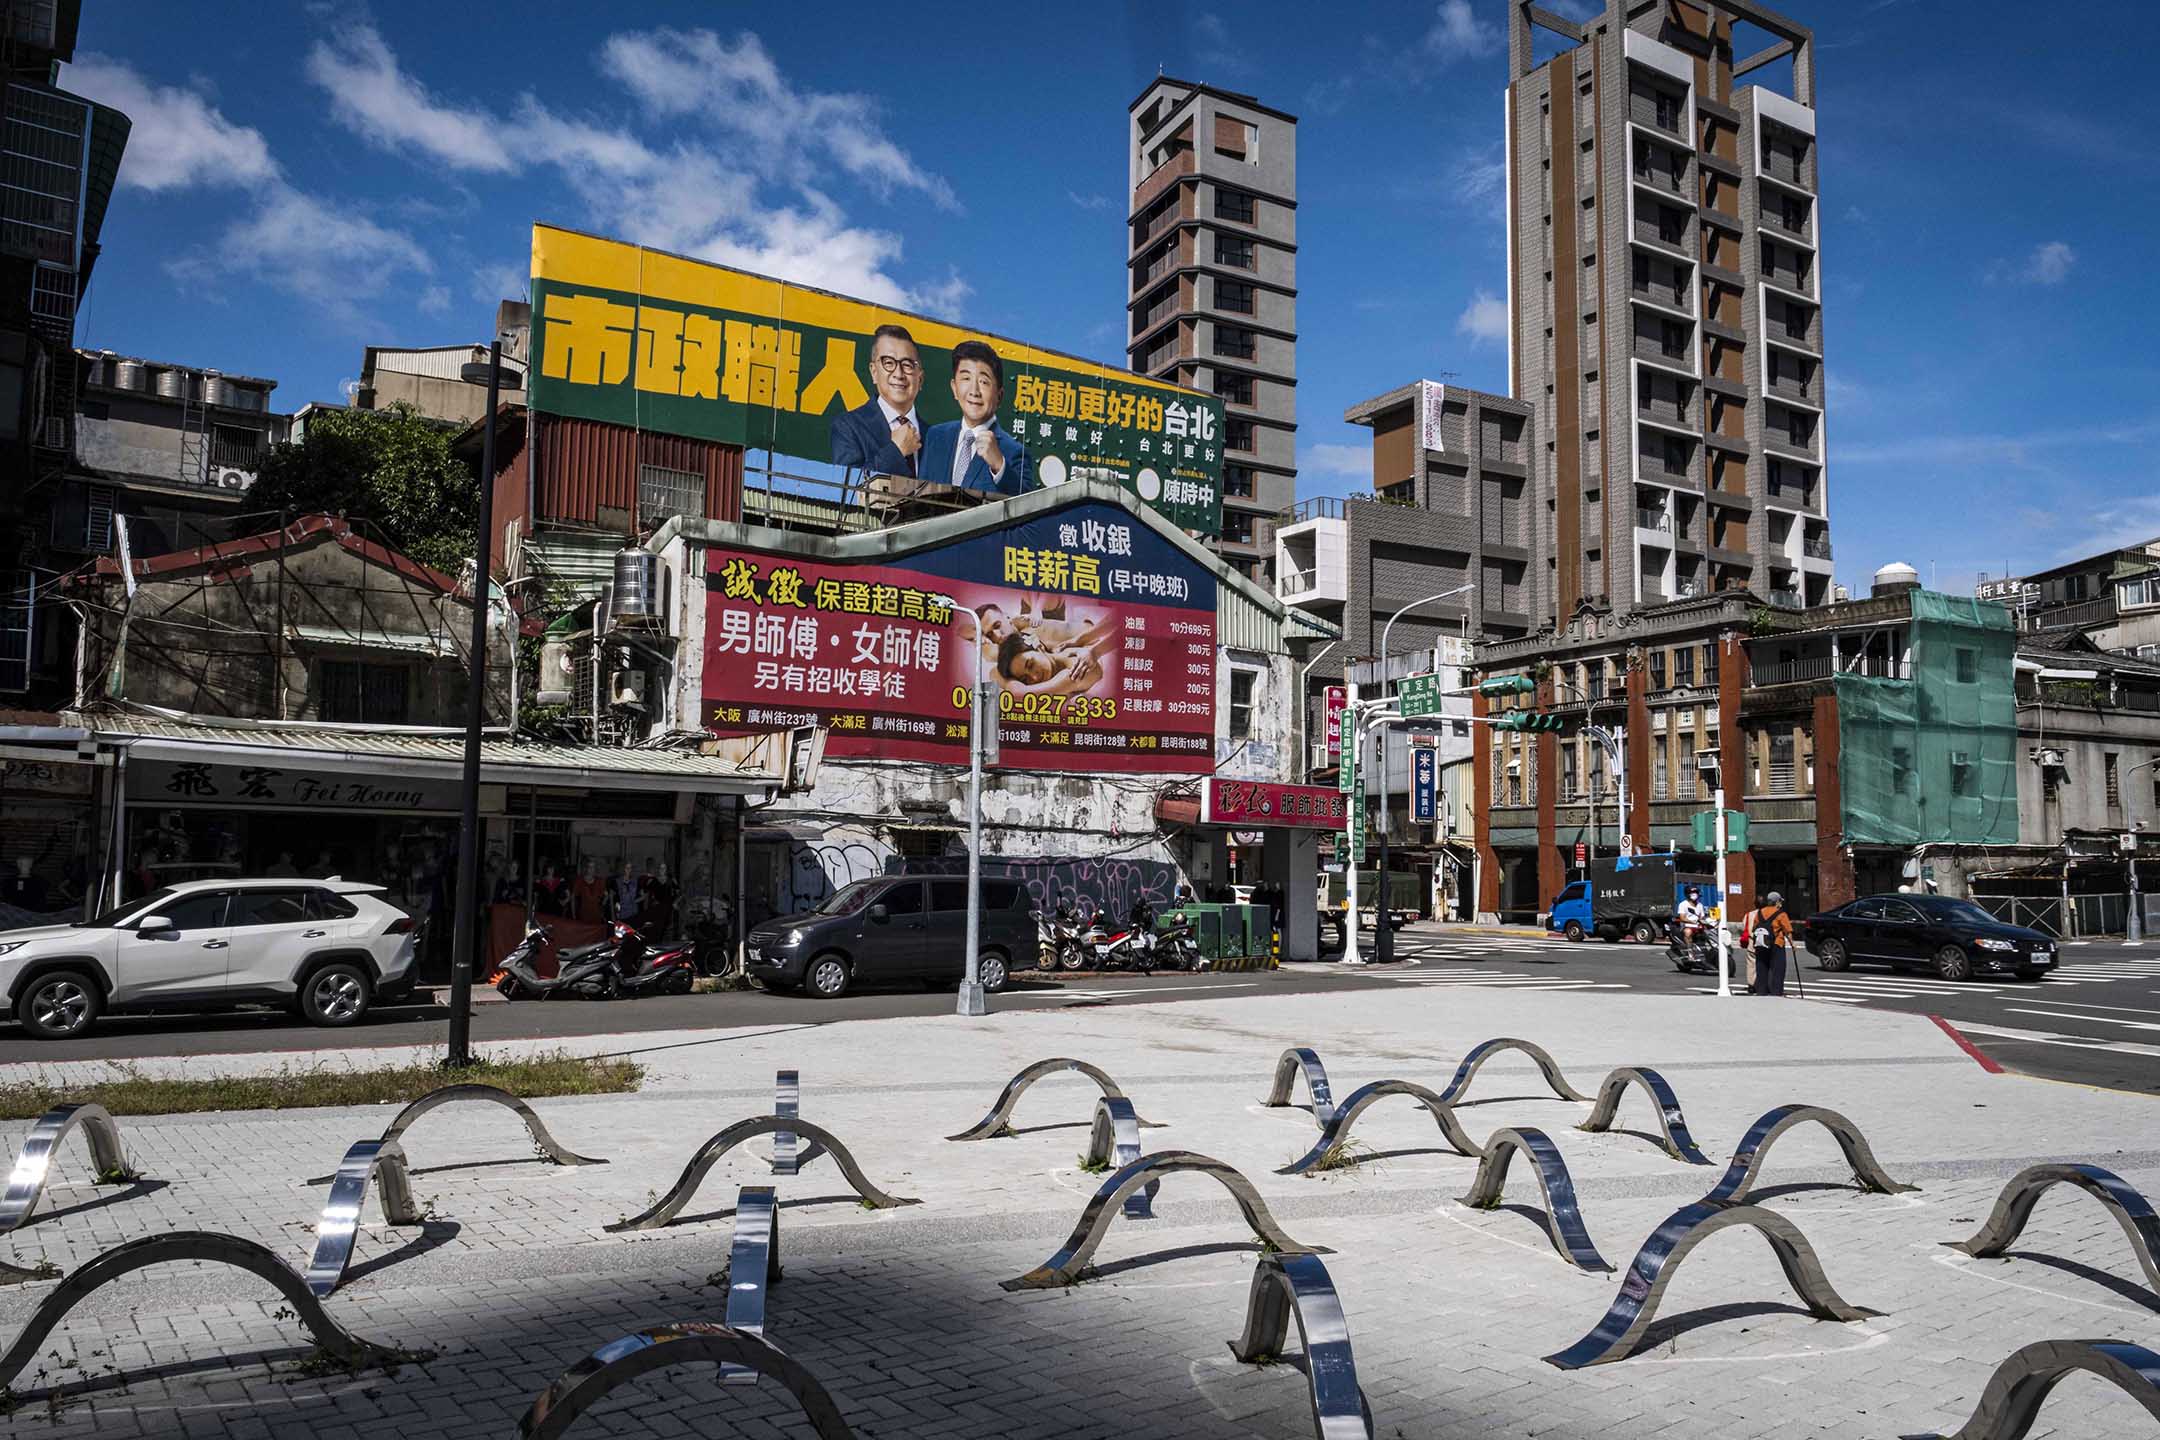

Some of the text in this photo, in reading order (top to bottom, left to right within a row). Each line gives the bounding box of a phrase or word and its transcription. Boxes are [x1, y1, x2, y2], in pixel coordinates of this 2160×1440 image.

[542, 293, 870, 416] 市政職人
[1163, 478, 1215, 509] 陳時中
[1058, 518, 1133, 557] 徵收銀
[720, 558, 807, 608] 誠徵
[1003, 545, 1189, 602] 時薪高 (早中晚班)
[1125, 616, 1212, 637] 油壓 70分699元
[1187, 643, 1211, 657] 300元
[754, 660, 906, 700] 另有招收學徒
[1124, 657, 1210, 676] 削腳皮 300元
[1123, 677, 1210, 696] 剪指甲 200元
[952, 686, 1118, 720] 00-027-333
[1167, 701, 1210, 716] 30分299元
[713, 706, 742, 723] 大阪
[747, 709, 819, 727] 廣州街237號
[829, 714, 866, 730] 大滿足
[872, 717, 936, 736] 廣州街169號
[1040, 731, 1070, 745] 大滿足
[1074, 733, 1127, 748] 昆明街128號
[1130, 735, 1157, 749] 大都會
[1280, 792, 1345, 818] 服飾批發
